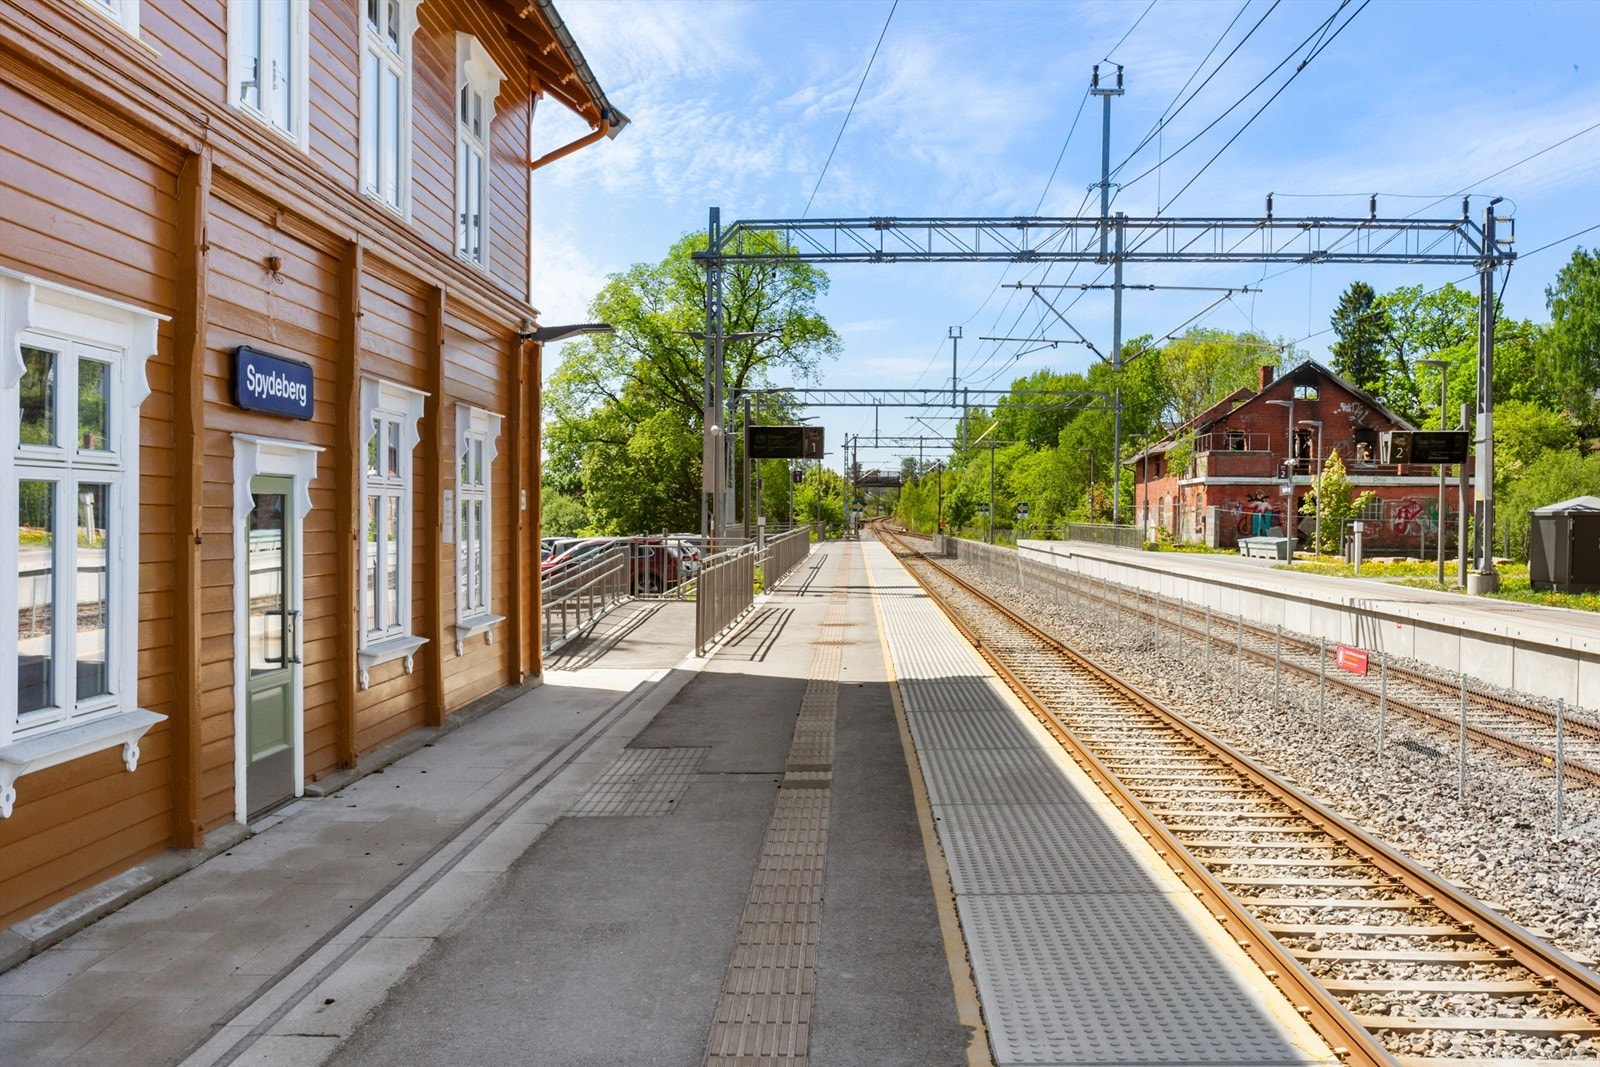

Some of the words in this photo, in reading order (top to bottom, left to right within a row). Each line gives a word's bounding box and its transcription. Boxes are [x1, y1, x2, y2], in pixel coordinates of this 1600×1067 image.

[246, 364, 307, 407] Spydeberg
[811, 442, 816, 453] 1
[1395, 447, 1404, 459] 2
[1280, 470, 1286, 478] 2
